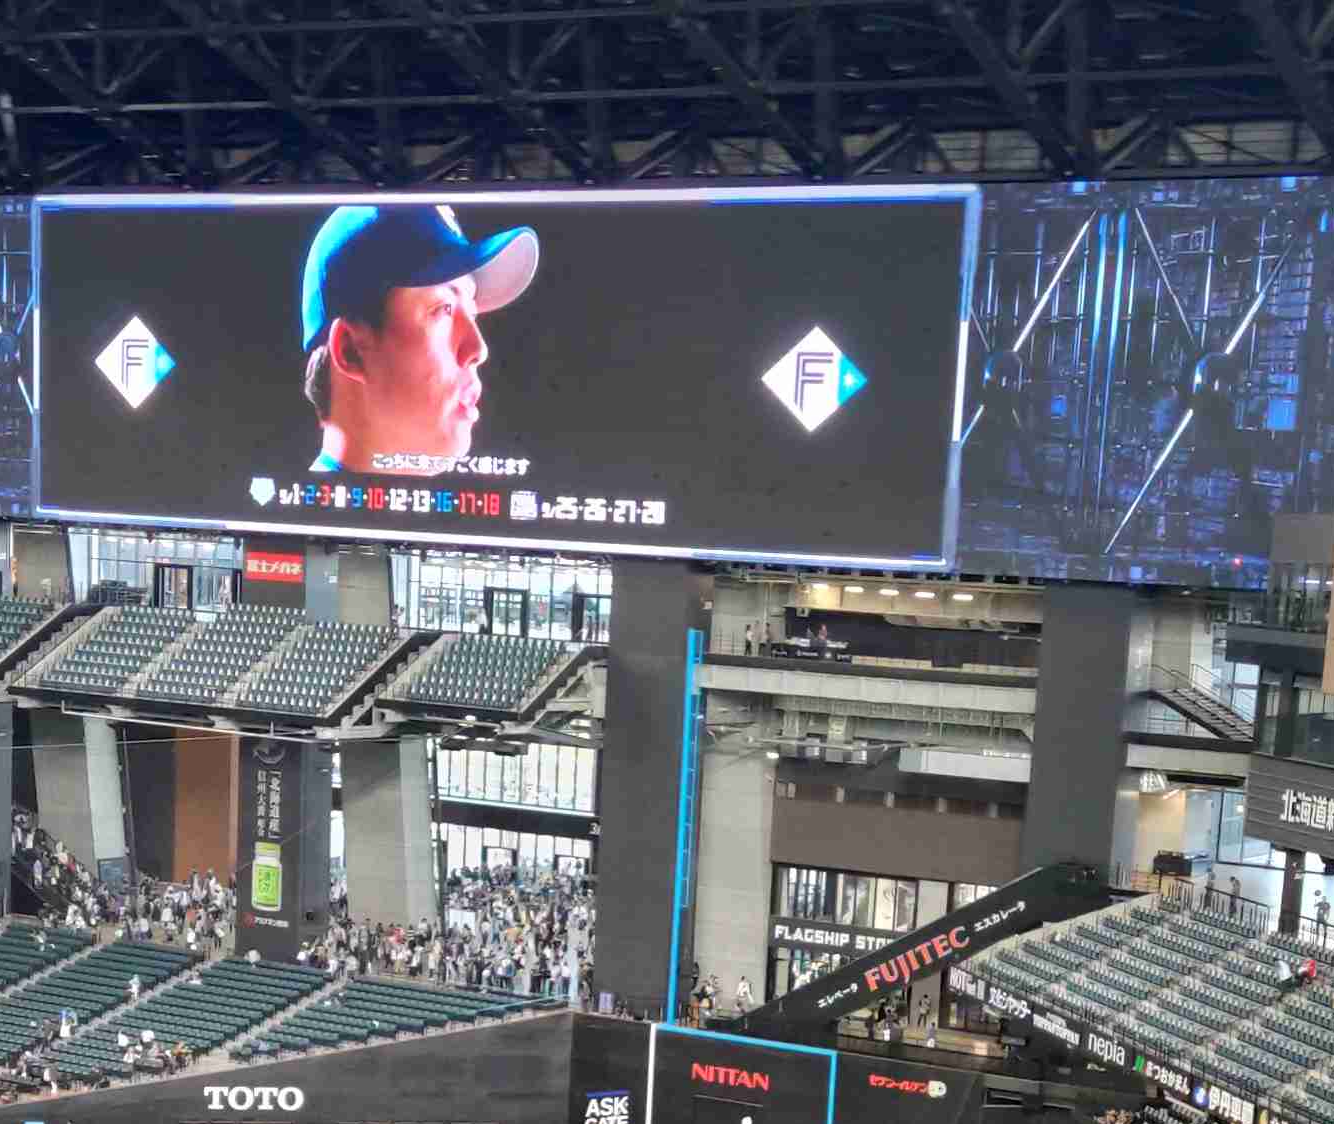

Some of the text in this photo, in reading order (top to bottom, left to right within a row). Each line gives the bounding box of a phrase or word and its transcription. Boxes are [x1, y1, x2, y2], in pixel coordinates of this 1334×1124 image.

[774, 924, 893, 951] FLAGSHIP STO
[863, 926, 971, 993] FUJITEC
[1088, 1032, 1125, 1067] nepia
[690, 1062, 770, 1091] NITTAN
[203, 1086, 305, 1112] TOTO
[585, 1095, 630, 1118] ASK
